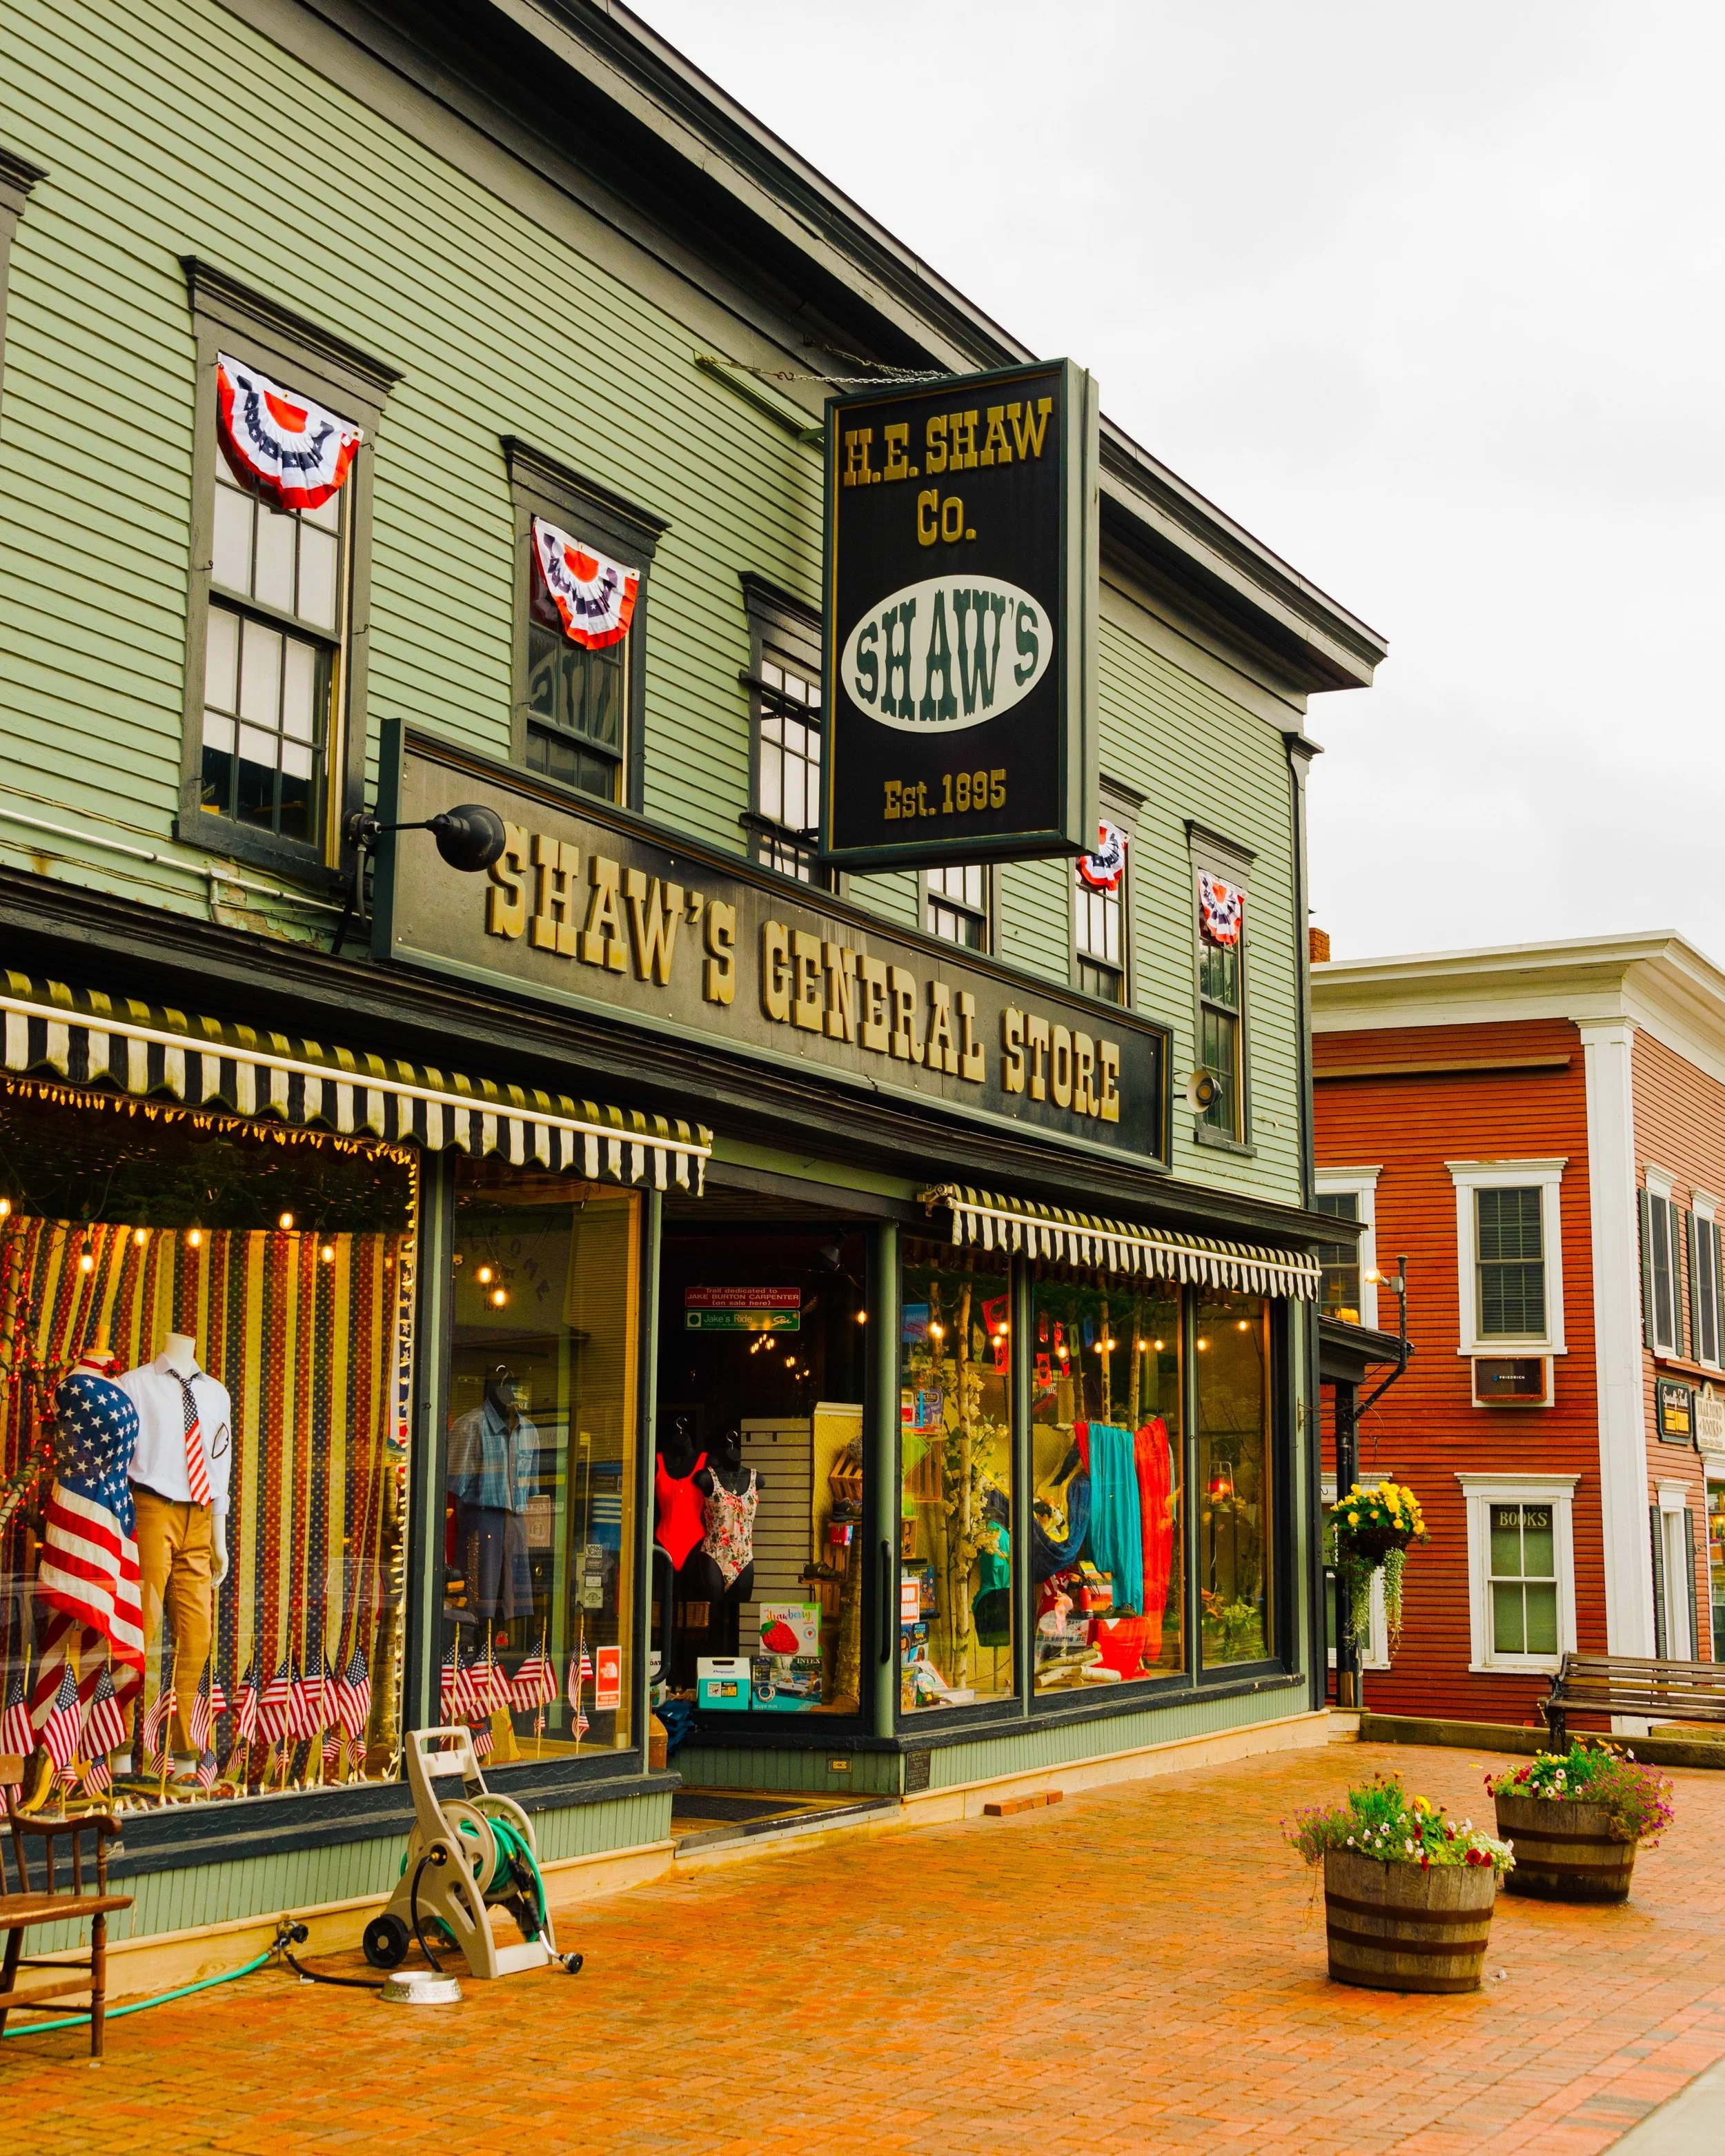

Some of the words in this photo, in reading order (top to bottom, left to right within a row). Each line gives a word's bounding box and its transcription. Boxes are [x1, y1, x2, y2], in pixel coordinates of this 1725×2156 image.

[844, 422, 920, 487] H.E.
[926, 397, 1053, 475] SHAW
[855, 589, 1038, 722] SHAW'S
[884, 780, 937, 820] Est.
[942, 769, 1007, 815] 1895
[486, 821, 736, 1006] SHAW'S
[761, 920, 986, 1084] GENERAL
[1001, 1007, 1121, 1123] STORE
[703, 1314, 730, 1323] Jake's
[733, 1314, 753, 1323] Ride
[1499, 1512, 1548, 1526] BOOKS
[766, 1608, 813, 1621] strawberry
